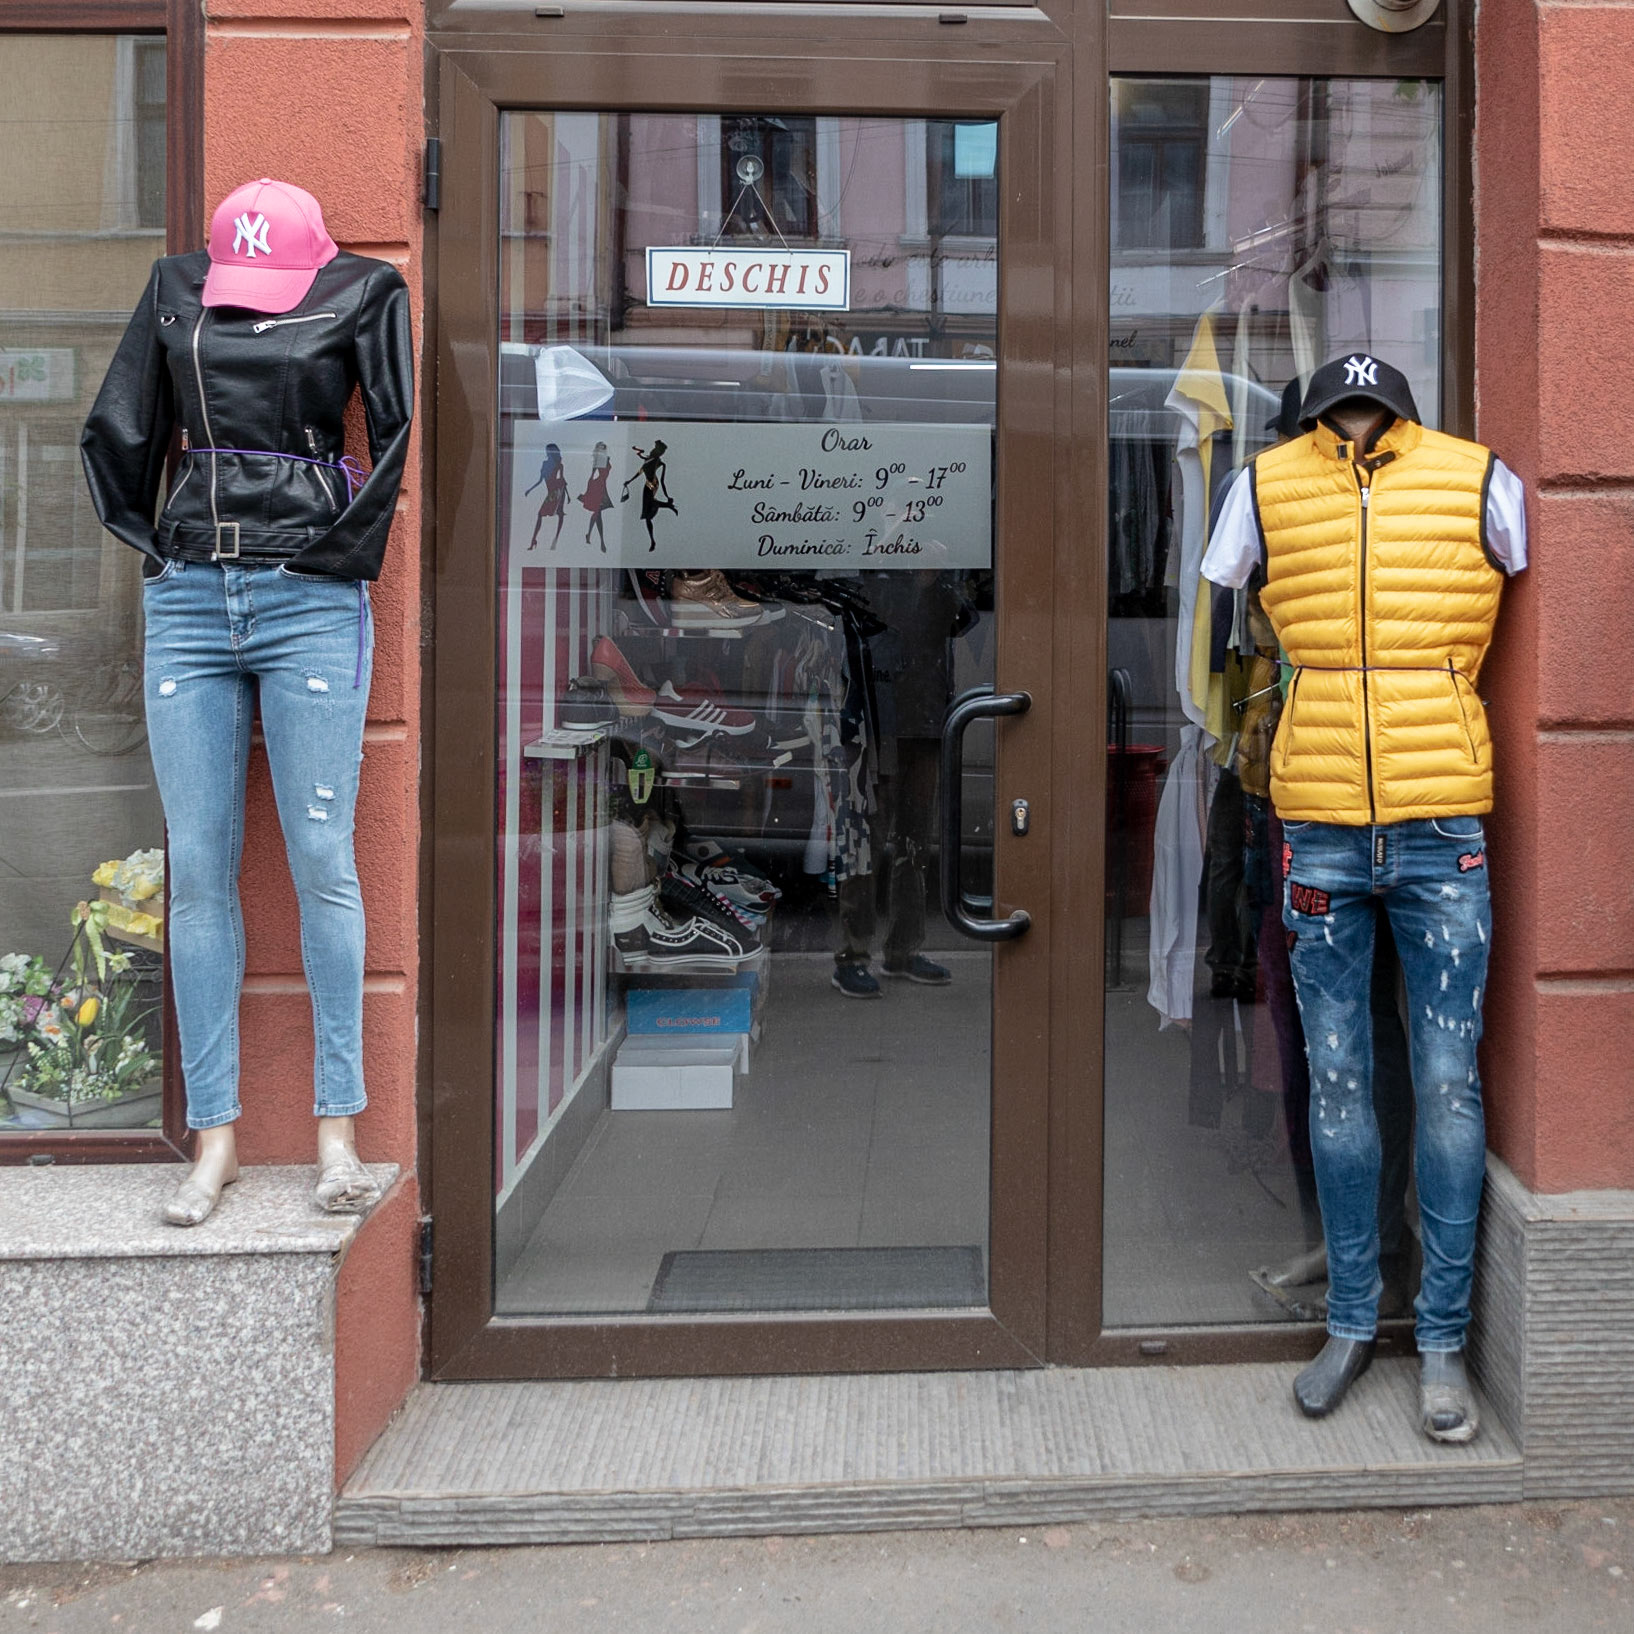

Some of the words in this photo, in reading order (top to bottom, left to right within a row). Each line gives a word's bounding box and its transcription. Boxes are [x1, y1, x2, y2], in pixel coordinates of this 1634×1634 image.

[665, 262, 831, 295] DESCHIS
[821, 428, 872, 452] Orar
[728, 468, 774, 490] Luni
[799, 468, 863, 490] Vineri:
[751, 501, 840, 524] Sâmbătă:
[757, 534, 852, 557] Duminică:
[862, 528, 923, 556] Închis
